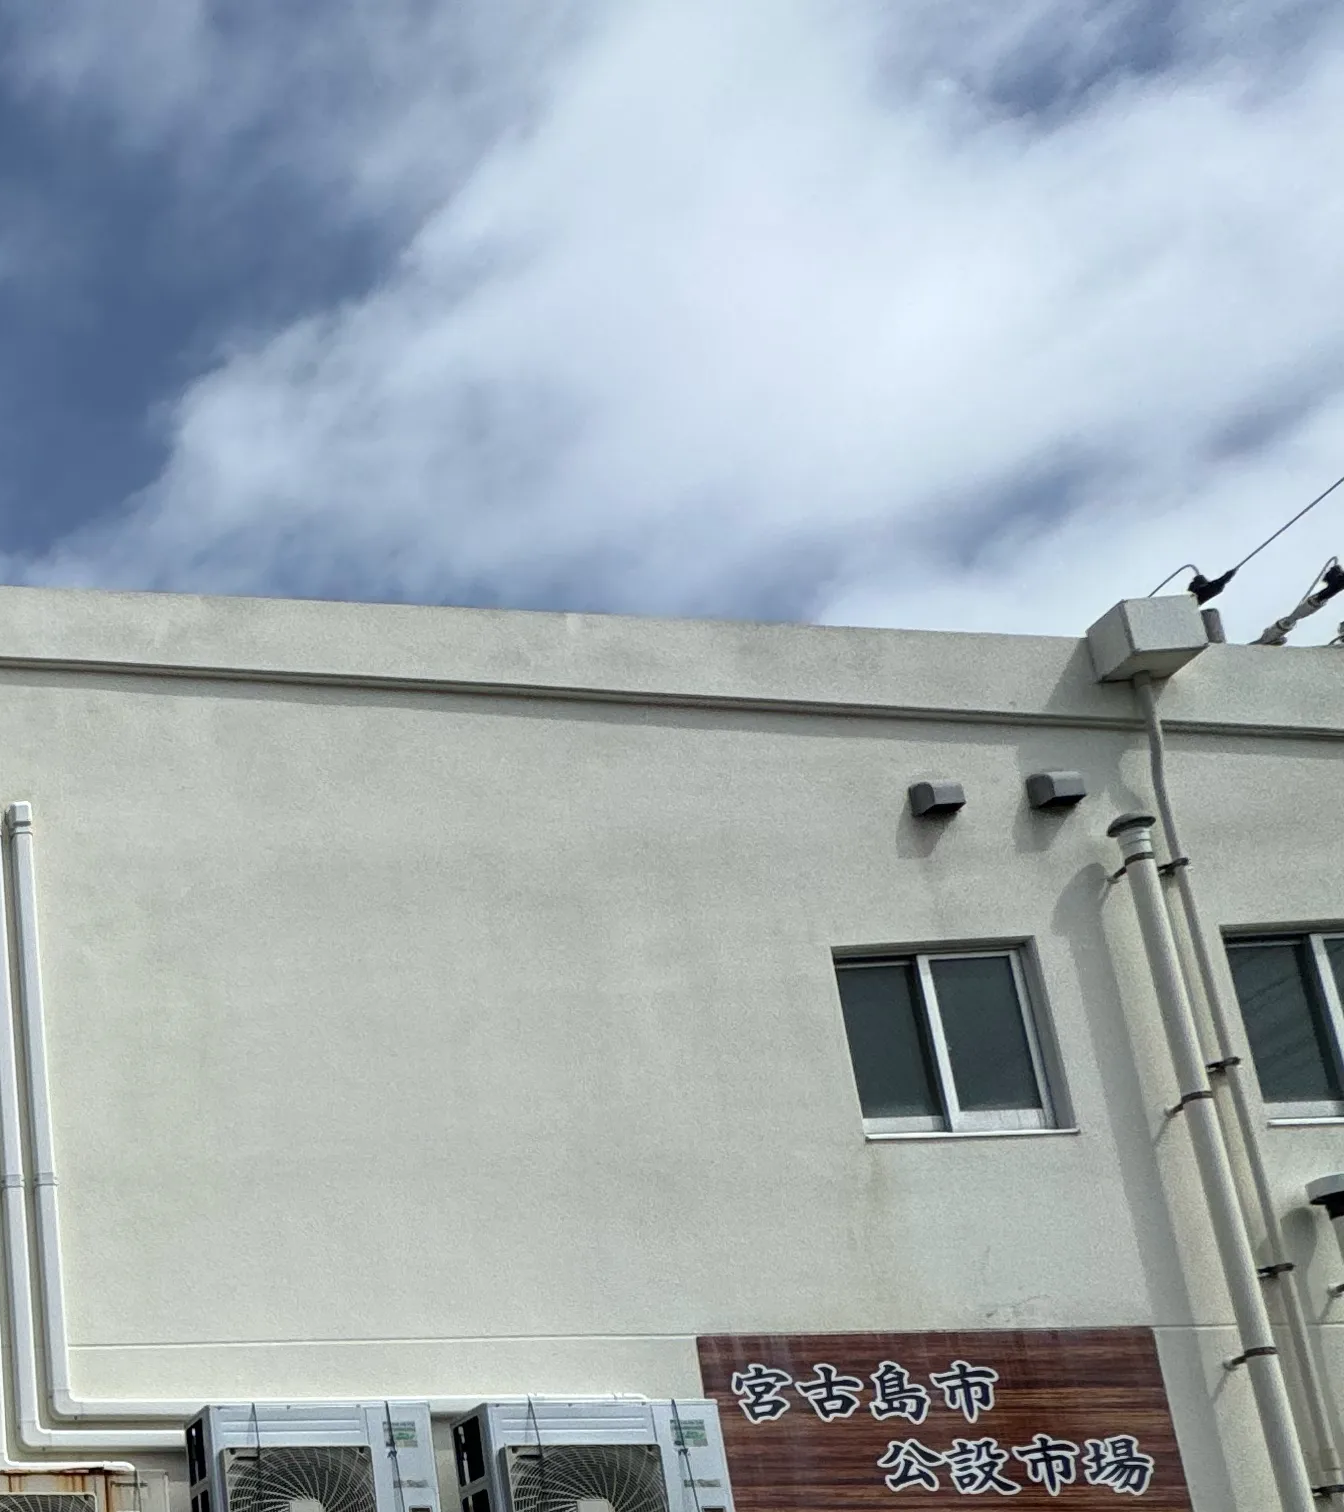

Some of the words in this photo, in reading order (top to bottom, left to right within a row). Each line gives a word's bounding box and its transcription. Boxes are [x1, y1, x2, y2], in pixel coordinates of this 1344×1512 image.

[732, 1360, 999, 1424] 宮古島市
[878, 1434, 1154, 1496] 公設市場
